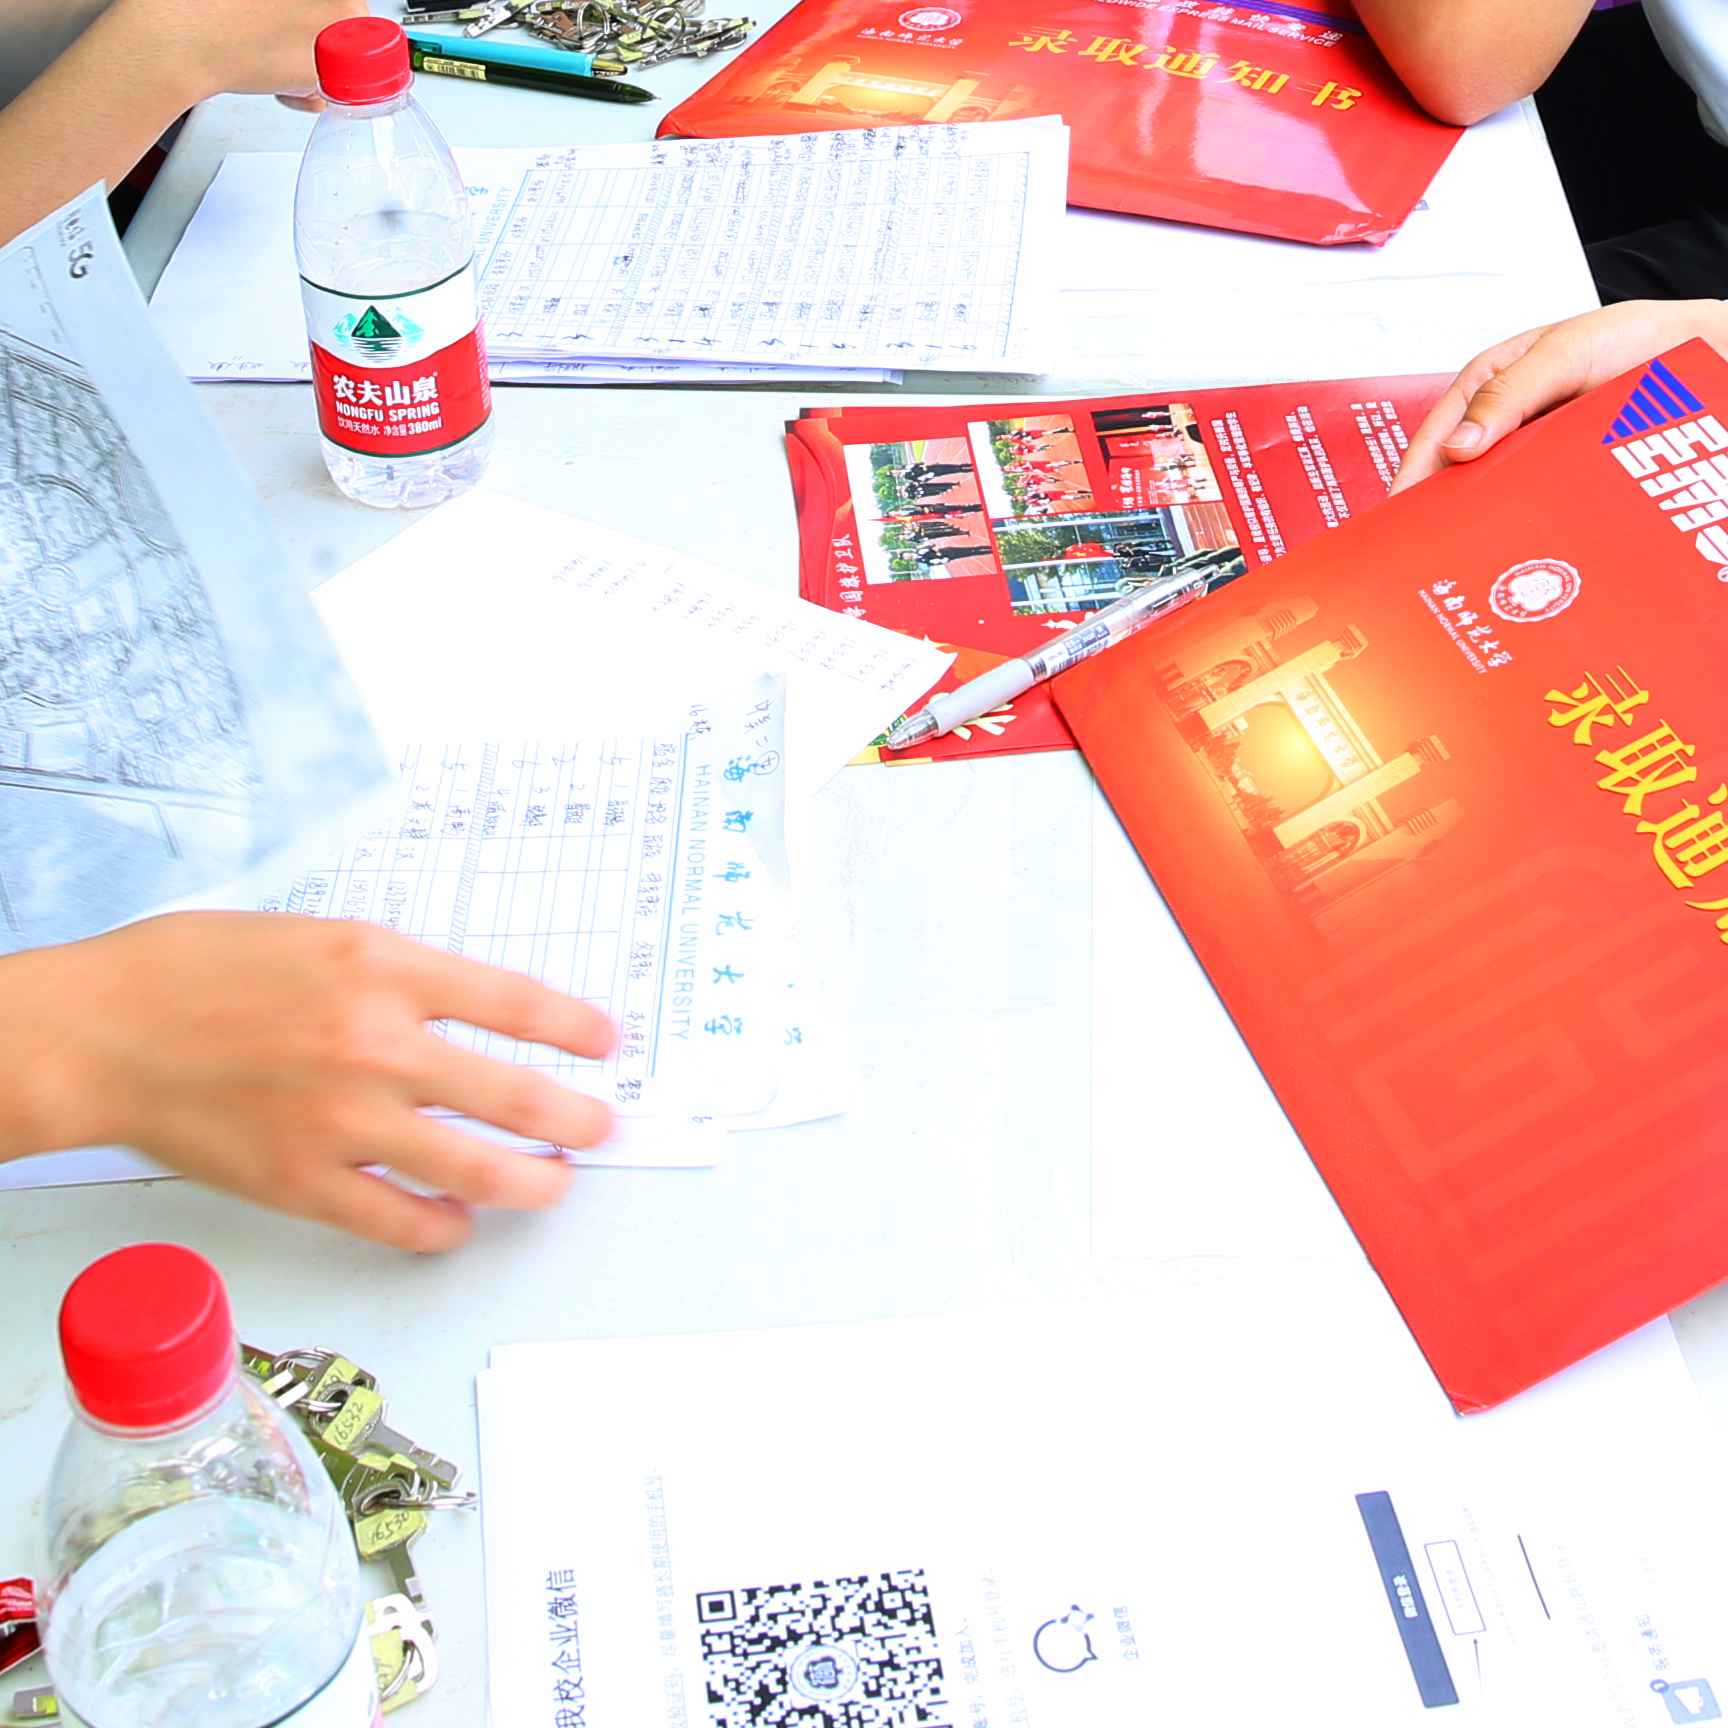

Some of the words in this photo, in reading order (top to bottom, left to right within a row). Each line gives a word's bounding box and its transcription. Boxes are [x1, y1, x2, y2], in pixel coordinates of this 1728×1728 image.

[1232, 15, 1264, 30] MAIL
[1264, 22, 1336, 49] SERVICE
[1008, 26, 1364, 112] 录取通知书
[333, 373, 439, 406] 农夫山泉
[336, 400, 384, 422] NONGFU
[389, 402, 440, 422] SPRING
[691, 765, 712, 834] HAINAN
[685, 837, 709, 915] NORMAL
[703, 754, 759, 1038] 海南师范大学
[669, 918, 699, 1042] UNIVERSITY
